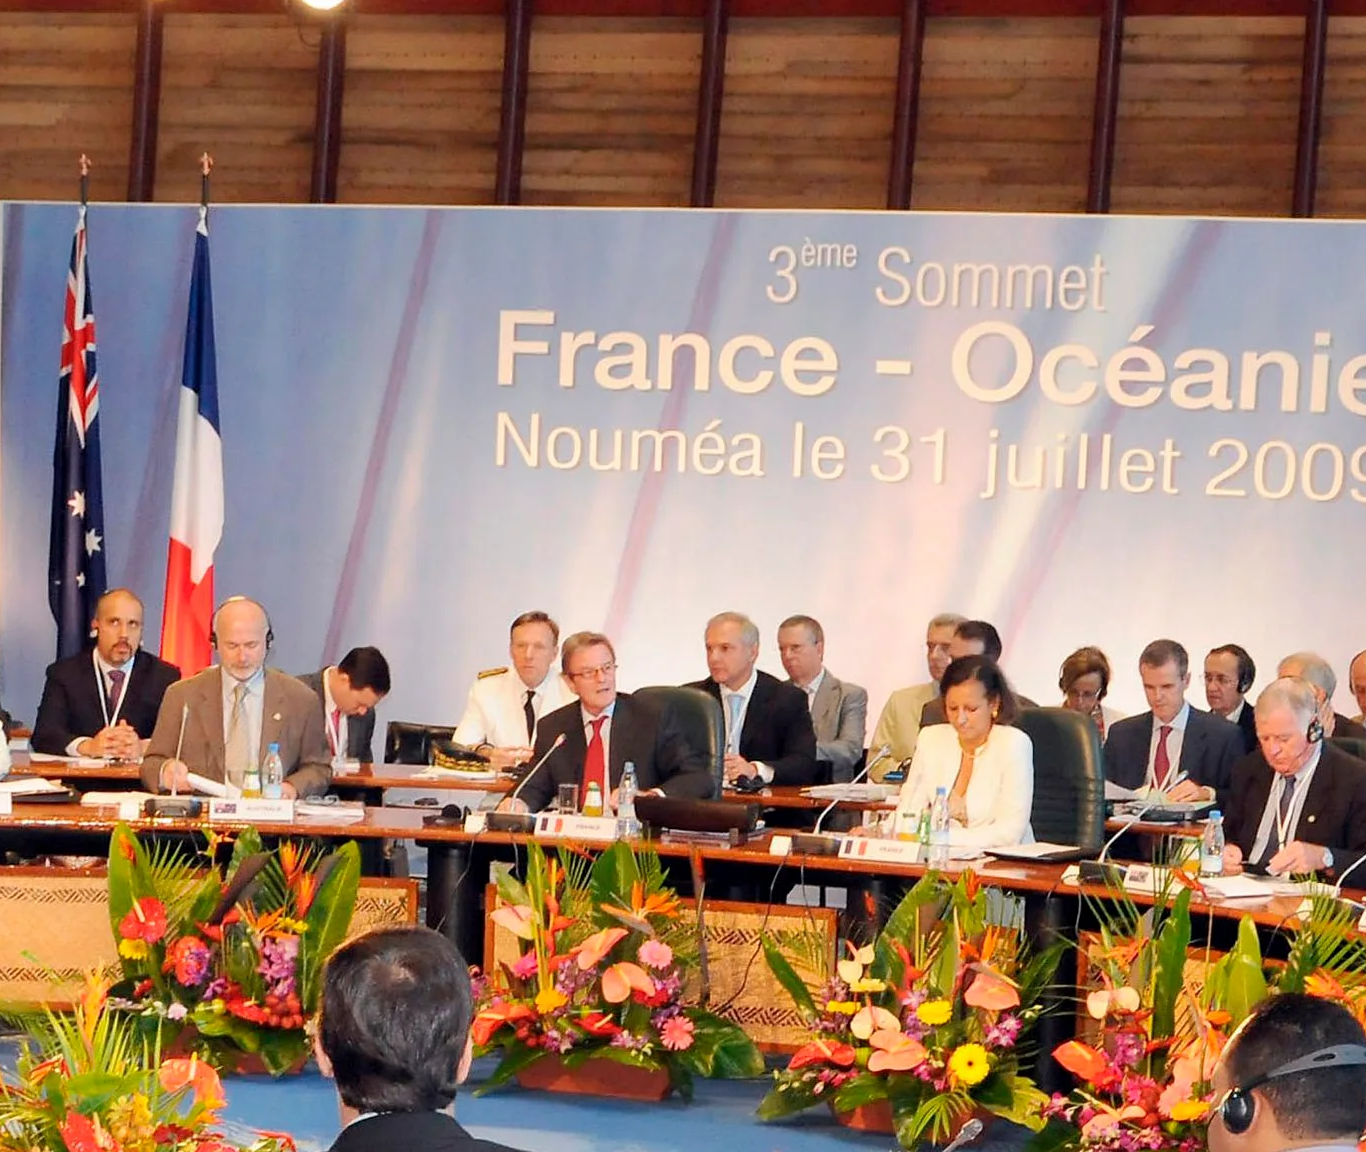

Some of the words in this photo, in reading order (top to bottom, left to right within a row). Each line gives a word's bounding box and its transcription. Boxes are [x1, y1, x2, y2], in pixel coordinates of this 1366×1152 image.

[766, 238, 858, 303] 3ème
[875, 247, 1107, 312] Sommet
[496, 309, 838, 396] France
[875, 360, 912, 375] -
[494, 412, 766, 478] Nouméa
[792, 422, 846, 480] le
[869, 426, 950, 485] 31
[979, 429, 1181, 499] juillet
